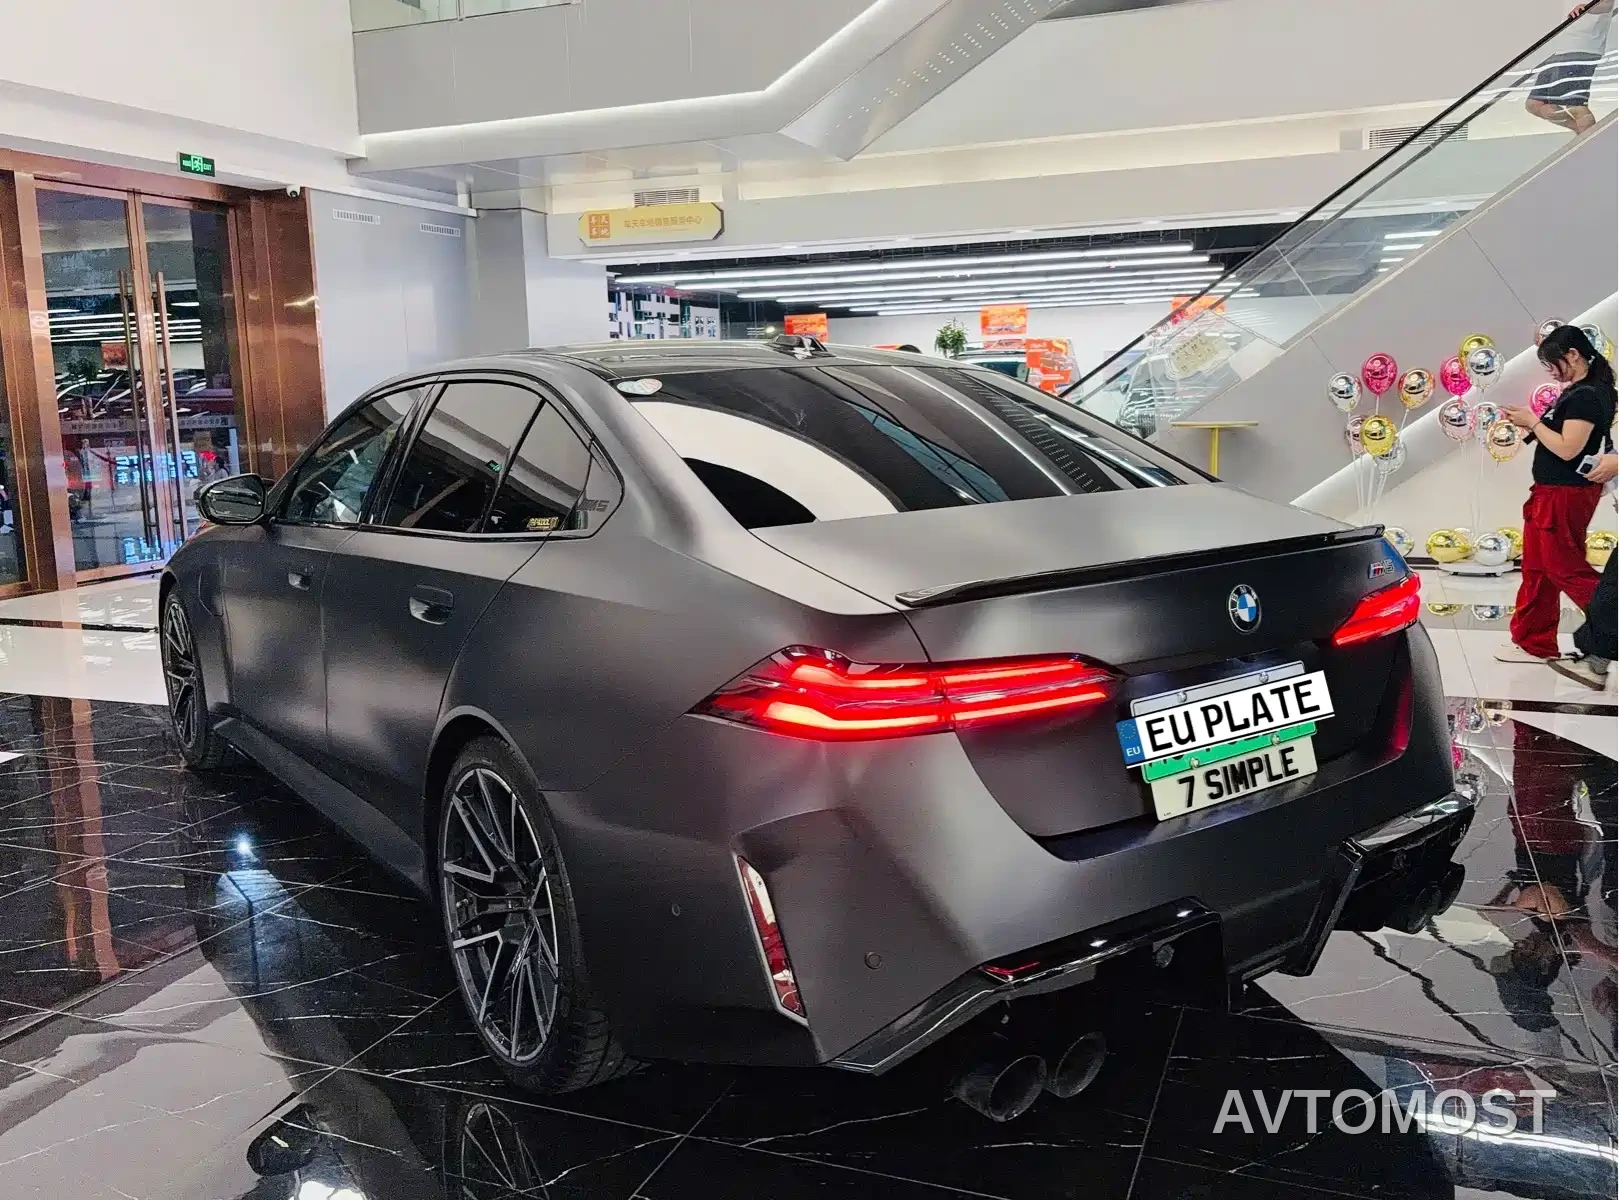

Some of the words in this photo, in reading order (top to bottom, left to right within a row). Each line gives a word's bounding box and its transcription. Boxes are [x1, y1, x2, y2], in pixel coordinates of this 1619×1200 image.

[1145, 710, 1196, 753] EU
[1200, 679, 1321, 738] PLATE
[1126, 746, 1142, 758] EU
[1178, 775, 1196, 808] 7
[1204, 746, 1300, 801] SIMPLE
